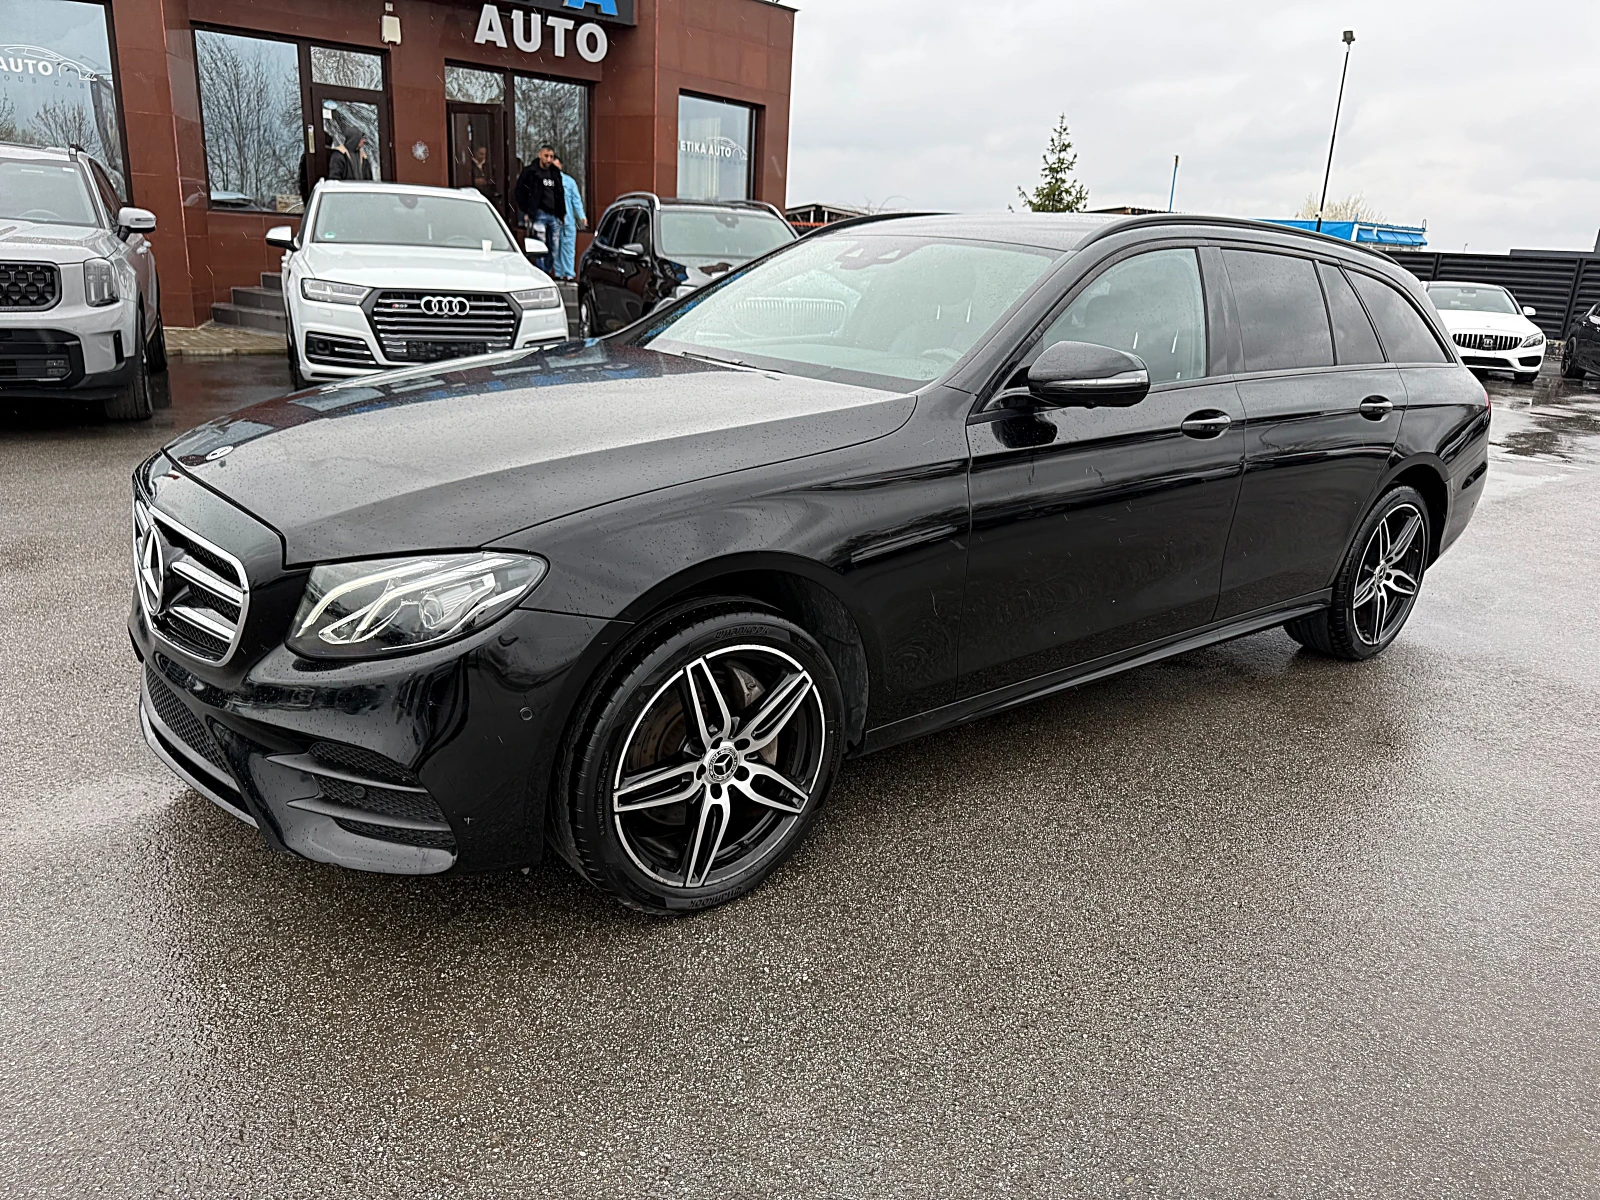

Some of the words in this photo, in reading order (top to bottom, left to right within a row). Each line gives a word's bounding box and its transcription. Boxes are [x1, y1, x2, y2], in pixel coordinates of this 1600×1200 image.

[474, 4, 608, 63] AUTO
[680, 140, 706, 154] ETIKA
[708, 143, 732, 158] AUTO
